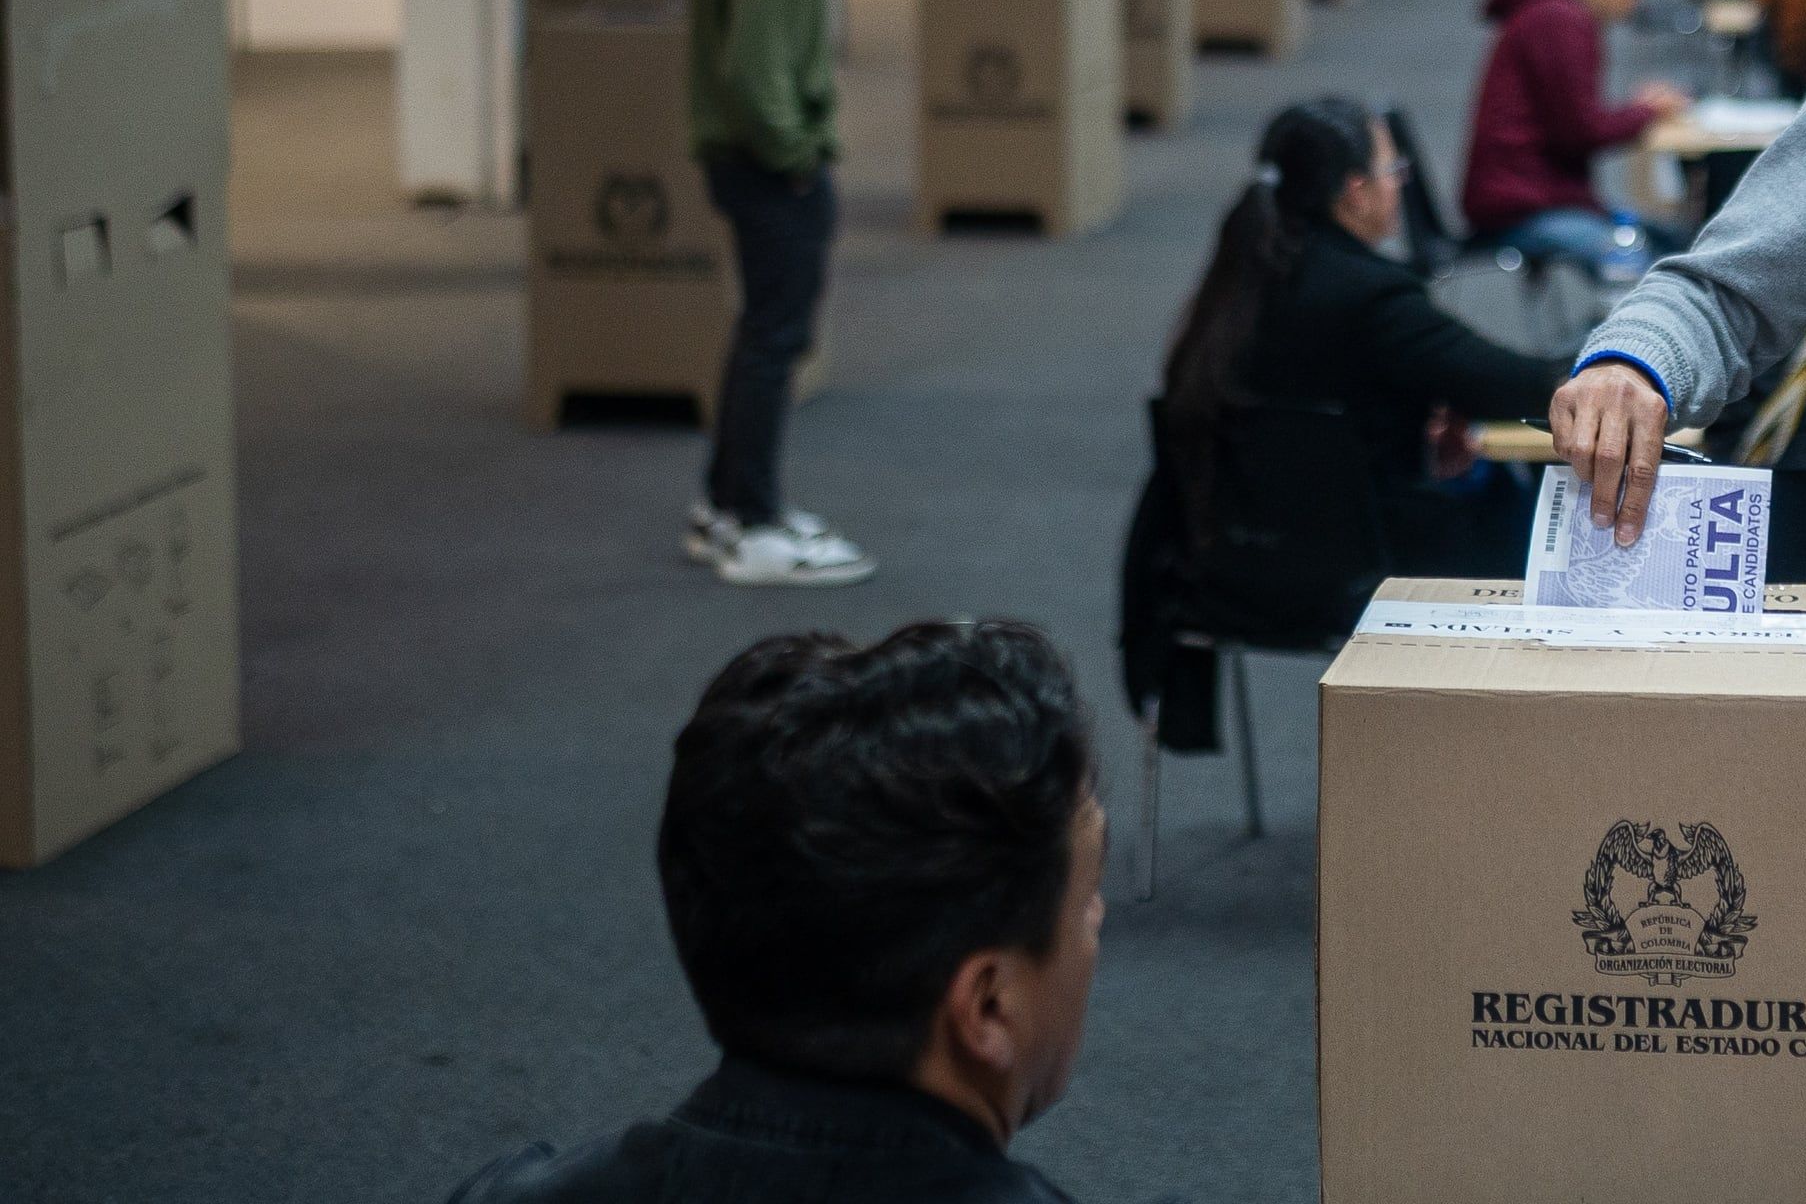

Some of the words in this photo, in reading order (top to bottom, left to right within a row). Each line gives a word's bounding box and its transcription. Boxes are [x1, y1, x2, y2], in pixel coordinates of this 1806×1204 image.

[1689, 499, 1703, 520] LA
[1686, 525, 1701, 568] PARA
[1703, 489, 1745, 614] ULTA
[1743, 493, 1762, 600] CANDIDATOS
[1640, 914, 1692, 929] REPÚBLICA
[1660, 927, 1673, 935] DE
[1641, 938, 1691, 952] COLOMBIA
[1599, 956, 1673, 971] ORGANIZACIÓN
[1675, 959, 1733, 974] ELECTORAL
[1472, 1029, 1606, 1052] NACIONAL
[1617, 1032, 1668, 1054] DEL
[1675, 1033, 1777, 1057] ESTADO
